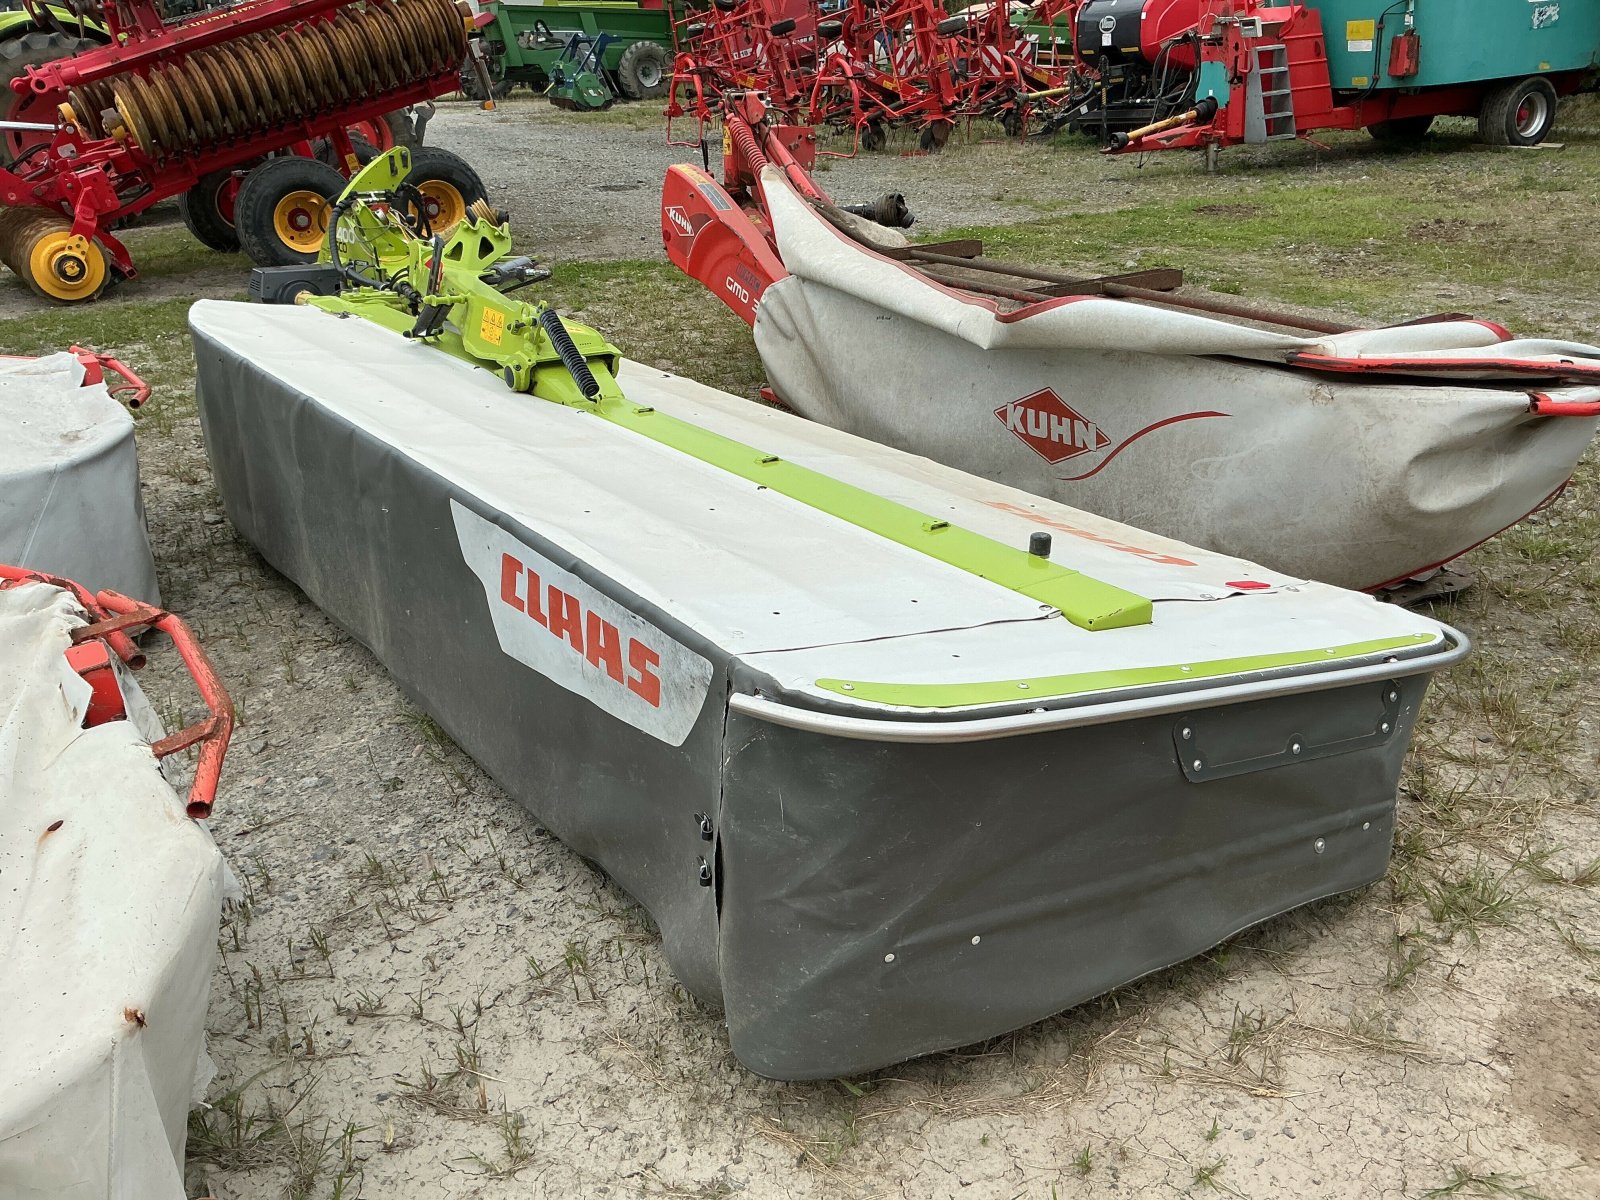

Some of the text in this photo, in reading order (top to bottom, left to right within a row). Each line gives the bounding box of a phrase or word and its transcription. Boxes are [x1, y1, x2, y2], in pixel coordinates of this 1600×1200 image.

[669, 207, 691, 235] KUHN
[726, 275, 749, 304] GMD
[1006, 401, 1097, 452] KUHN
[500, 552, 661, 708] CLAAS
